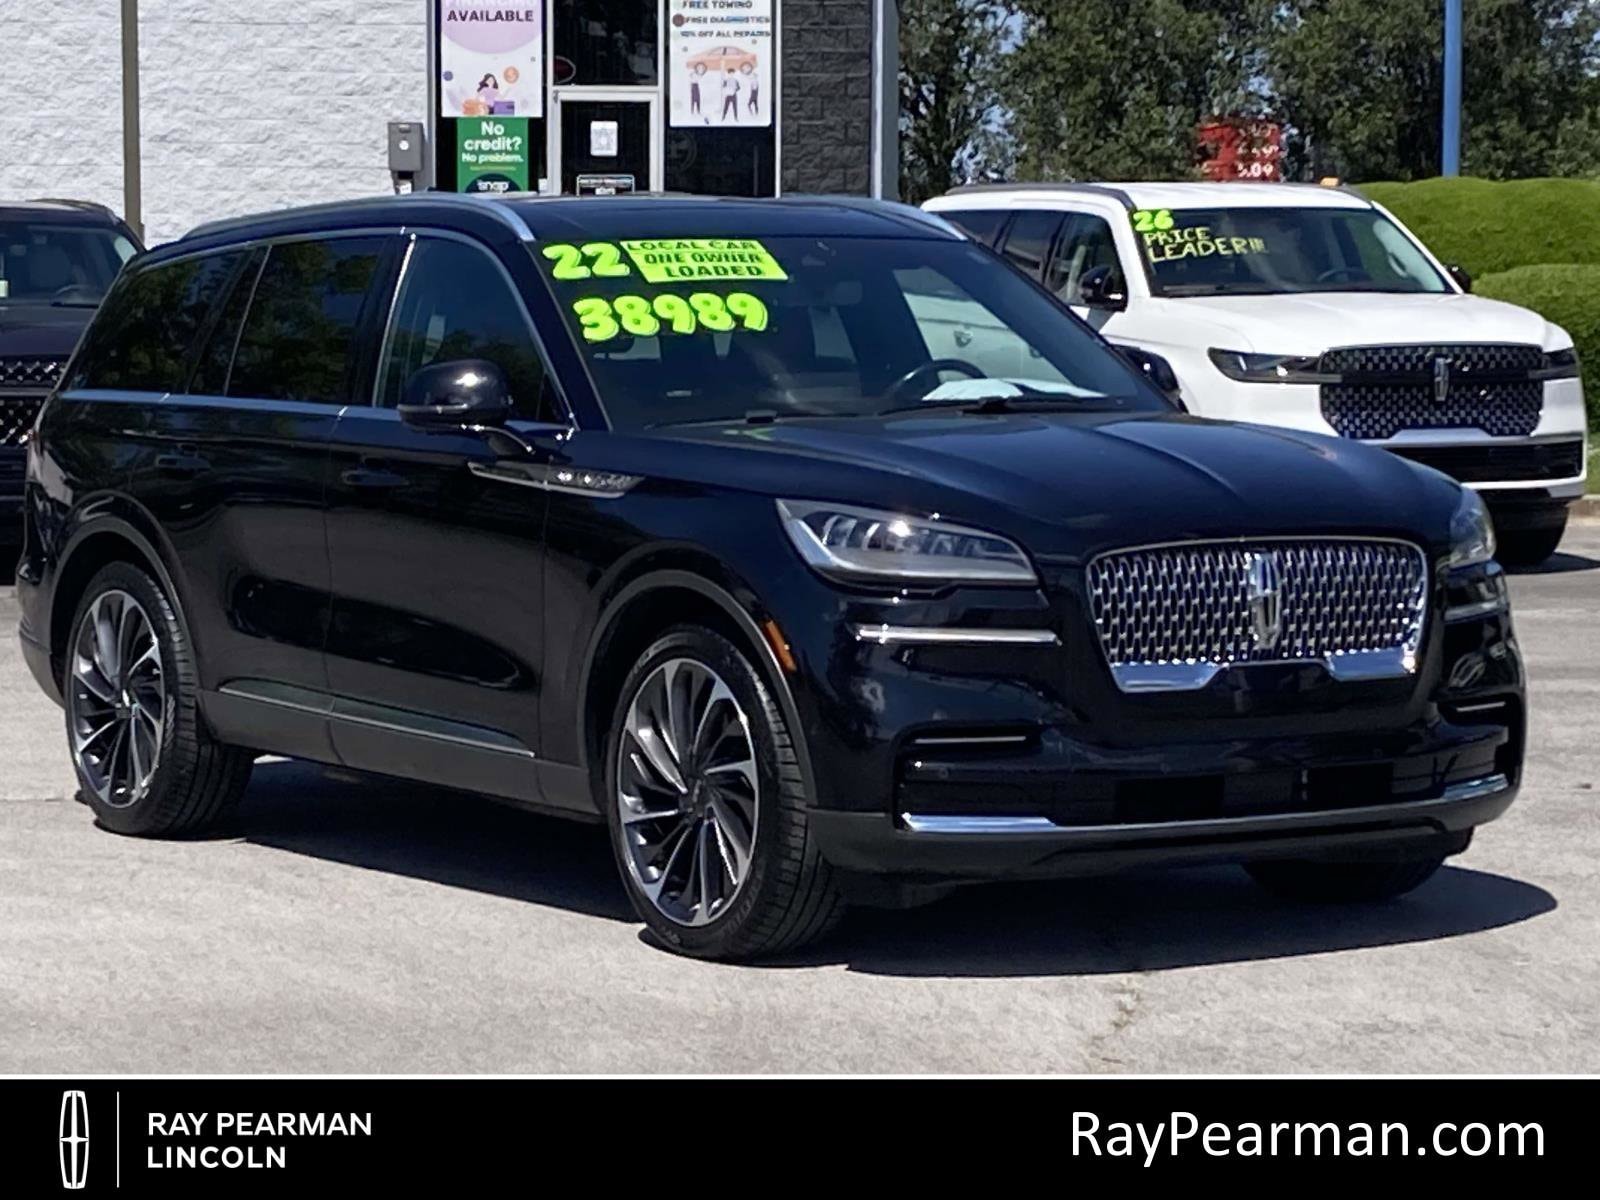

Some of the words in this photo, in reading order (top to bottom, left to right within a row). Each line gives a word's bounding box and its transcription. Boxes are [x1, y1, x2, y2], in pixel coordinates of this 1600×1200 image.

[447, 9, 534, 21] AVAILABLE
[481, 121, 504, 136] No
[464, 136, 522, 151] credit?
[461, 152, 477, 163] No
[478, 152, 524, 165] problem.
[1132, 210, 1174, 232] 26
[1144, 227, 1211, 246] PRICE
[626, 241, 705, 251] LOCAL
[708, 240, 760, 250] CAR
[542, 242, 631, 280] 22
[643, 253, 686, 264] ONE
[690, 252, 762, 263] OWNER
[664, 265, 763, 278] LOADED
[573, 292, 769, 342] 38989
